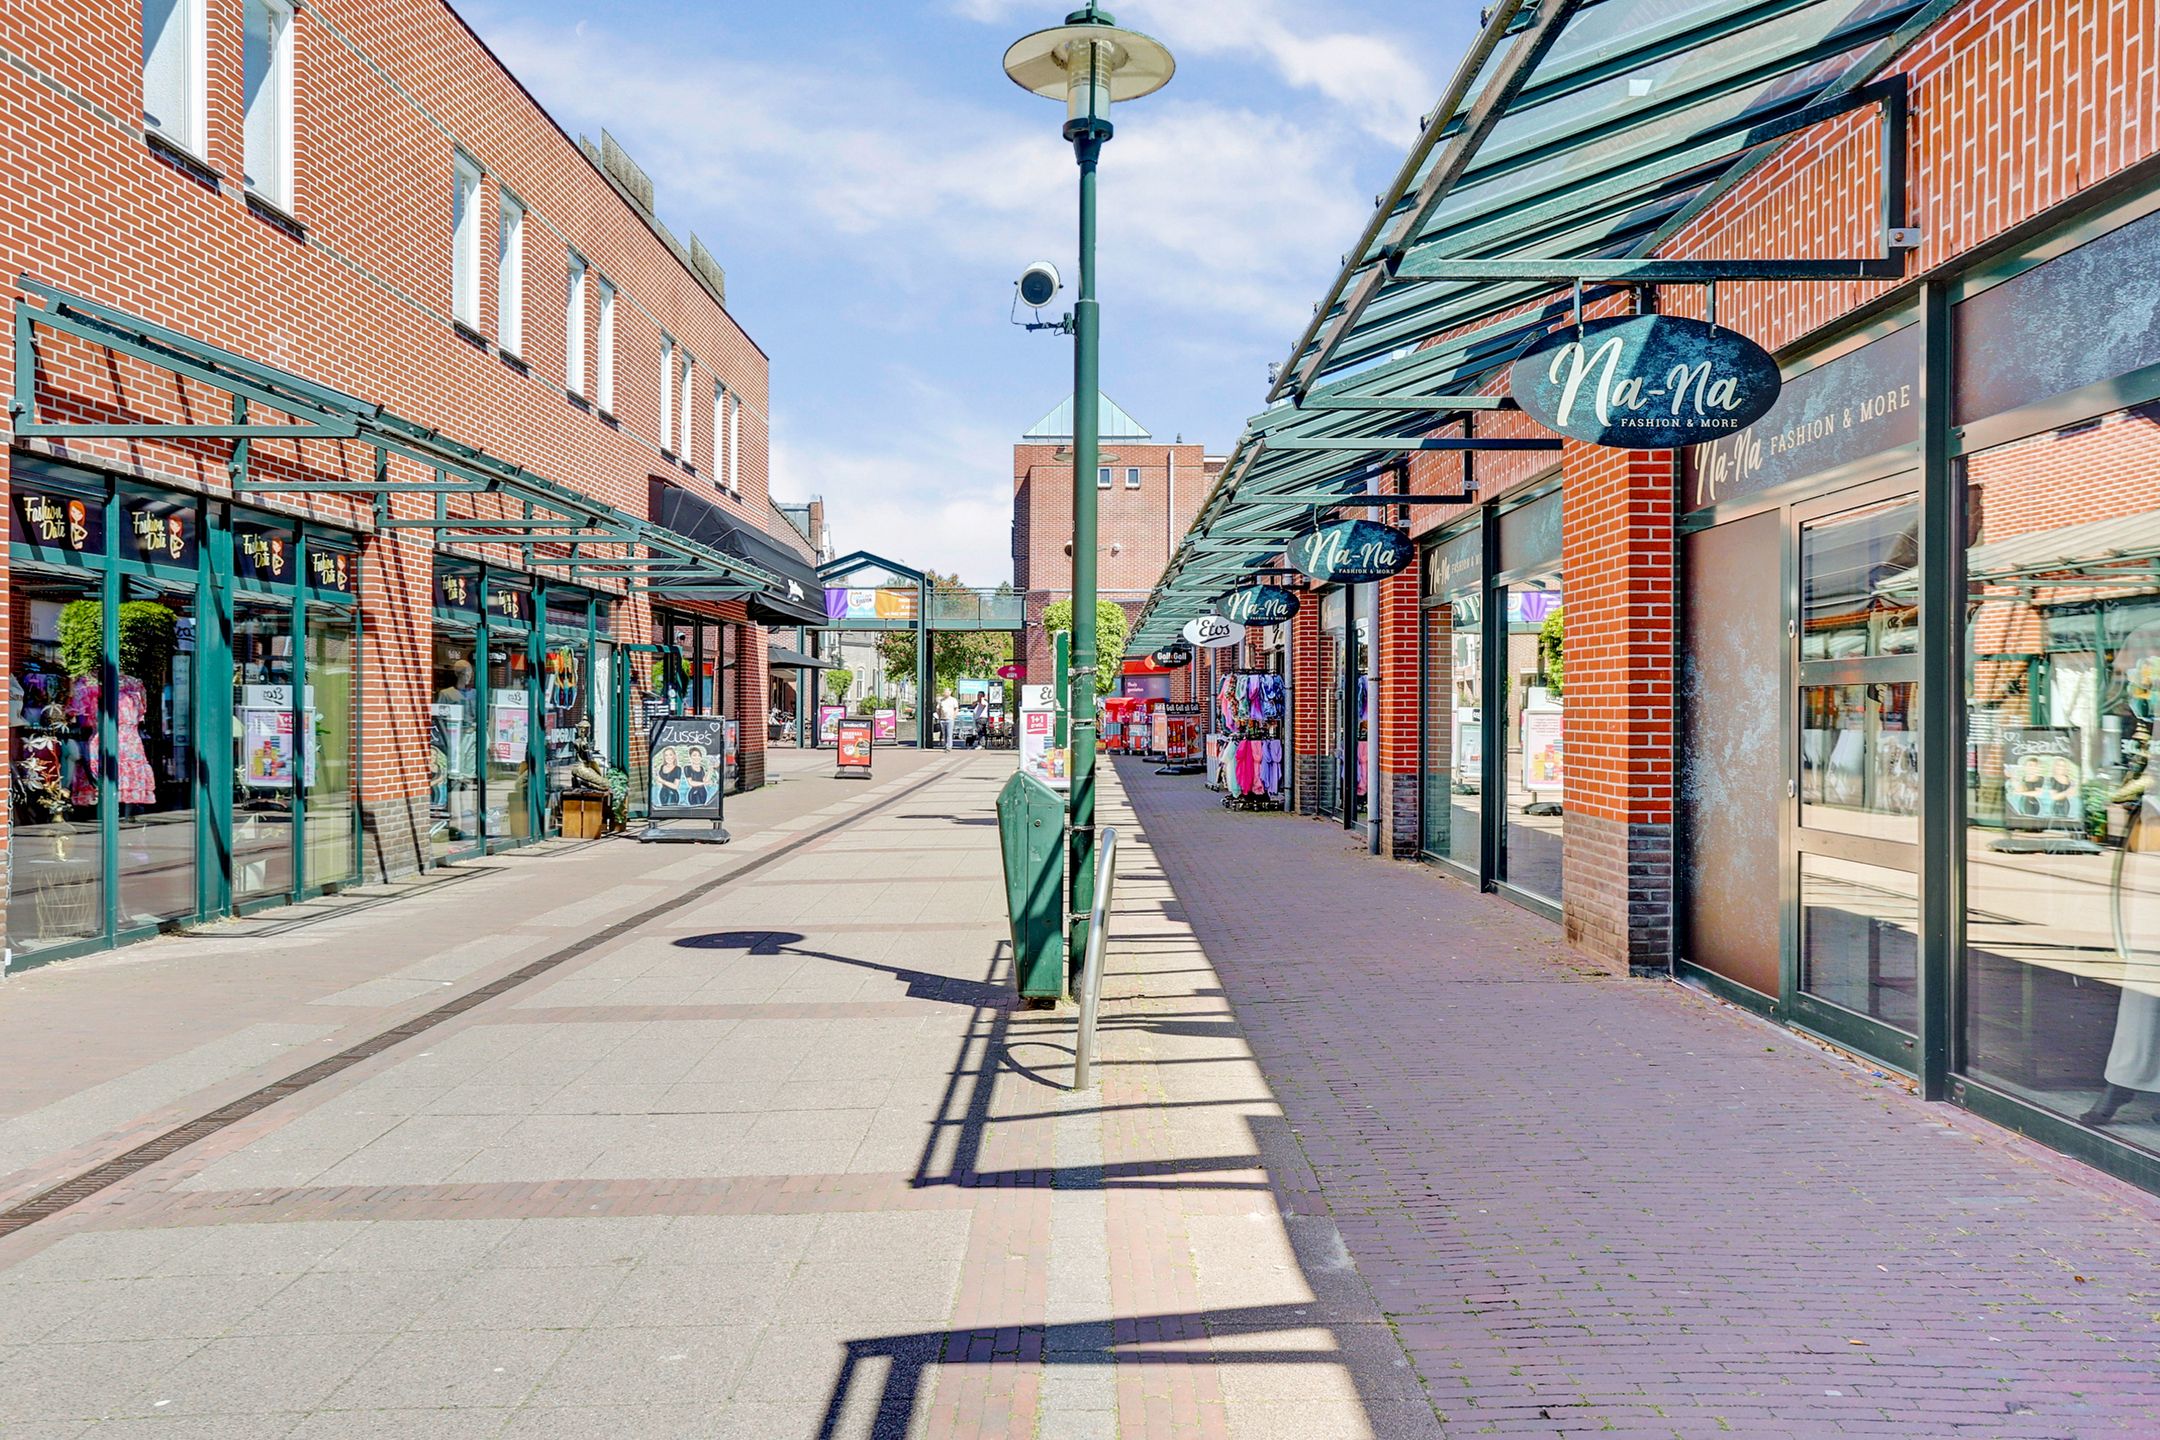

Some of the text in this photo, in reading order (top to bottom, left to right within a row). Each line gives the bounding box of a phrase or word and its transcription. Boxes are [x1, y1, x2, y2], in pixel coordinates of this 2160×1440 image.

[1549, 336, 1742, 427] Na-Na
[1620, 418, 1738, 428] FASHION & MORE
[1694, 384, 1910, 505] Na-Na FASHION & MORE
[23, 496, 64, 522] Fashion
[39, 519, 66, 541] Date
[145, 531, 167, 550] Date
[1304, 529, 1397, 573] Na-Na
[1228, 591, 1288, 620] Na-Na
[1199, 619, 1231, 638] Etos
[1157, 652, 1171, 661] Gall
[1174, 652, 1187, 660] Gall
[1040, 686, 1055, 700] Et
[662, 725, 713, 745] Zussie's
